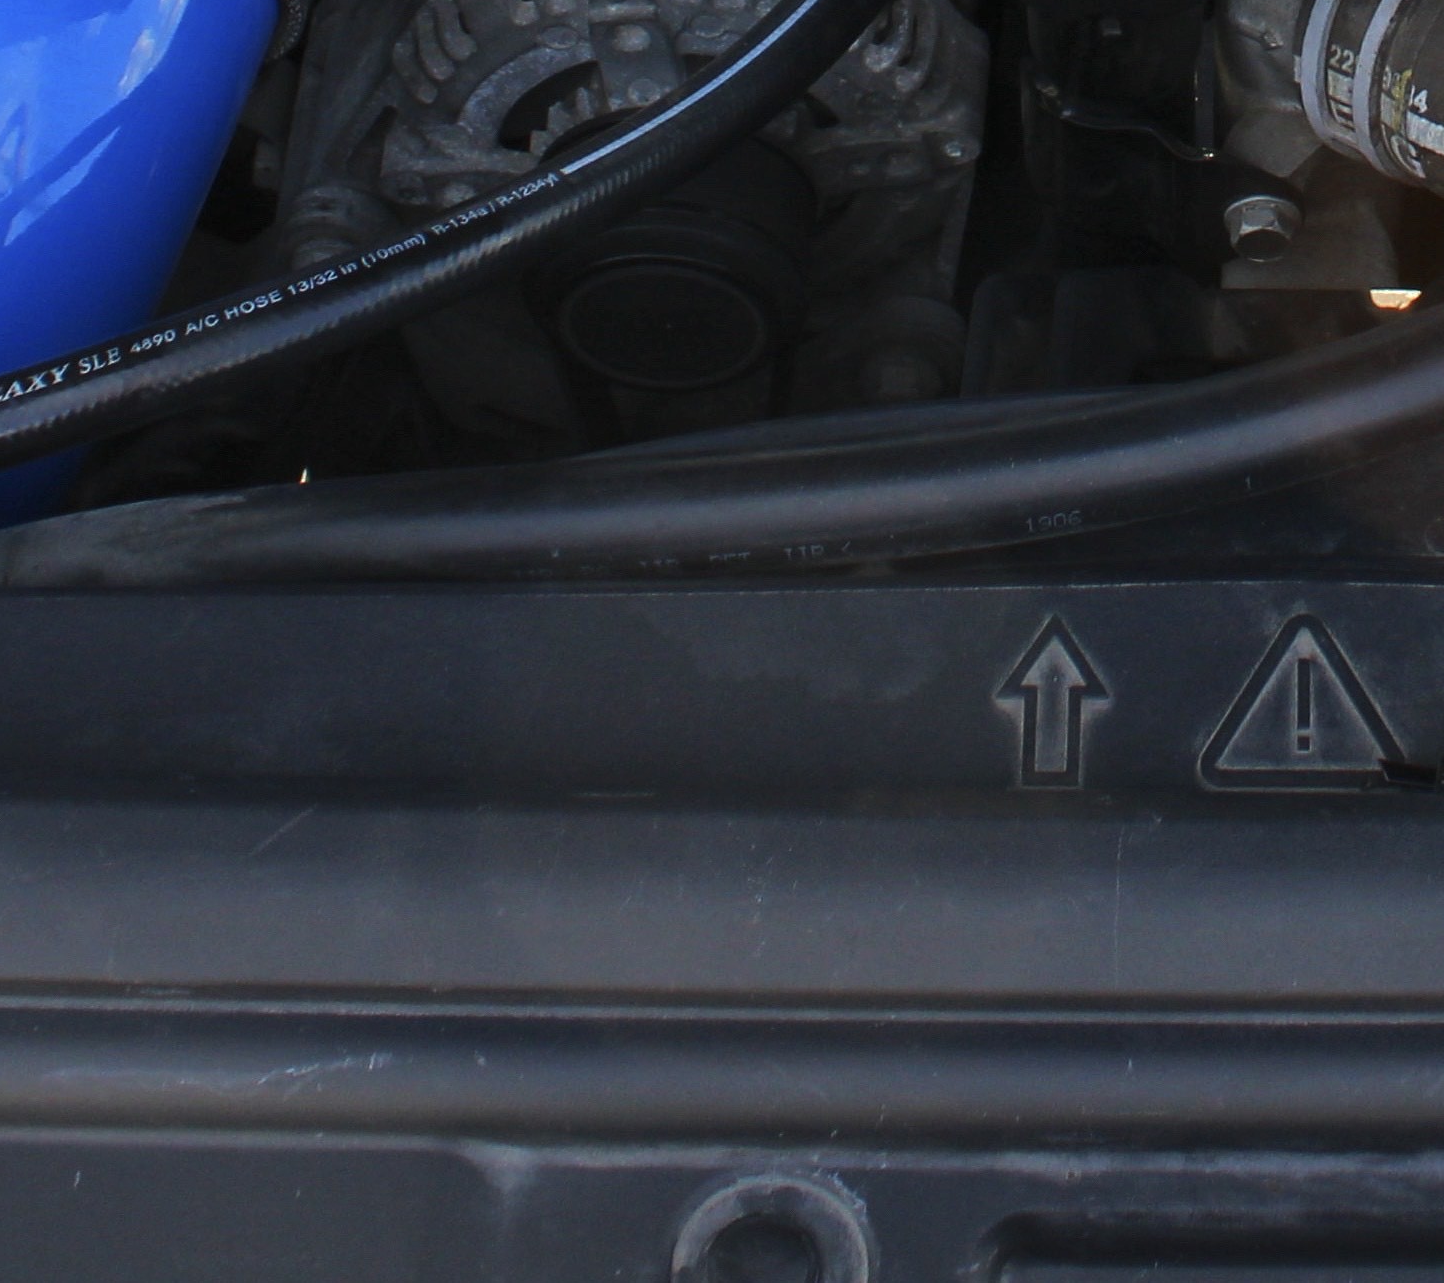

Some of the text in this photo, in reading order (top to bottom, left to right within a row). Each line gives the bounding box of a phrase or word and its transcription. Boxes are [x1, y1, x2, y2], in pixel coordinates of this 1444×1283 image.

[78, 346, 122, 375] SLE
[130, 328, 177, 354] 4890
[184, 314, 220, 335] A/C
[224, 289, 284, 321] HOSE
[287, 269, 338, 296] 13/32
[340, 261, 358, 276] in
[360, 233, 427, 269] (10mm)
[431, 205, 488, 235] R-134a
